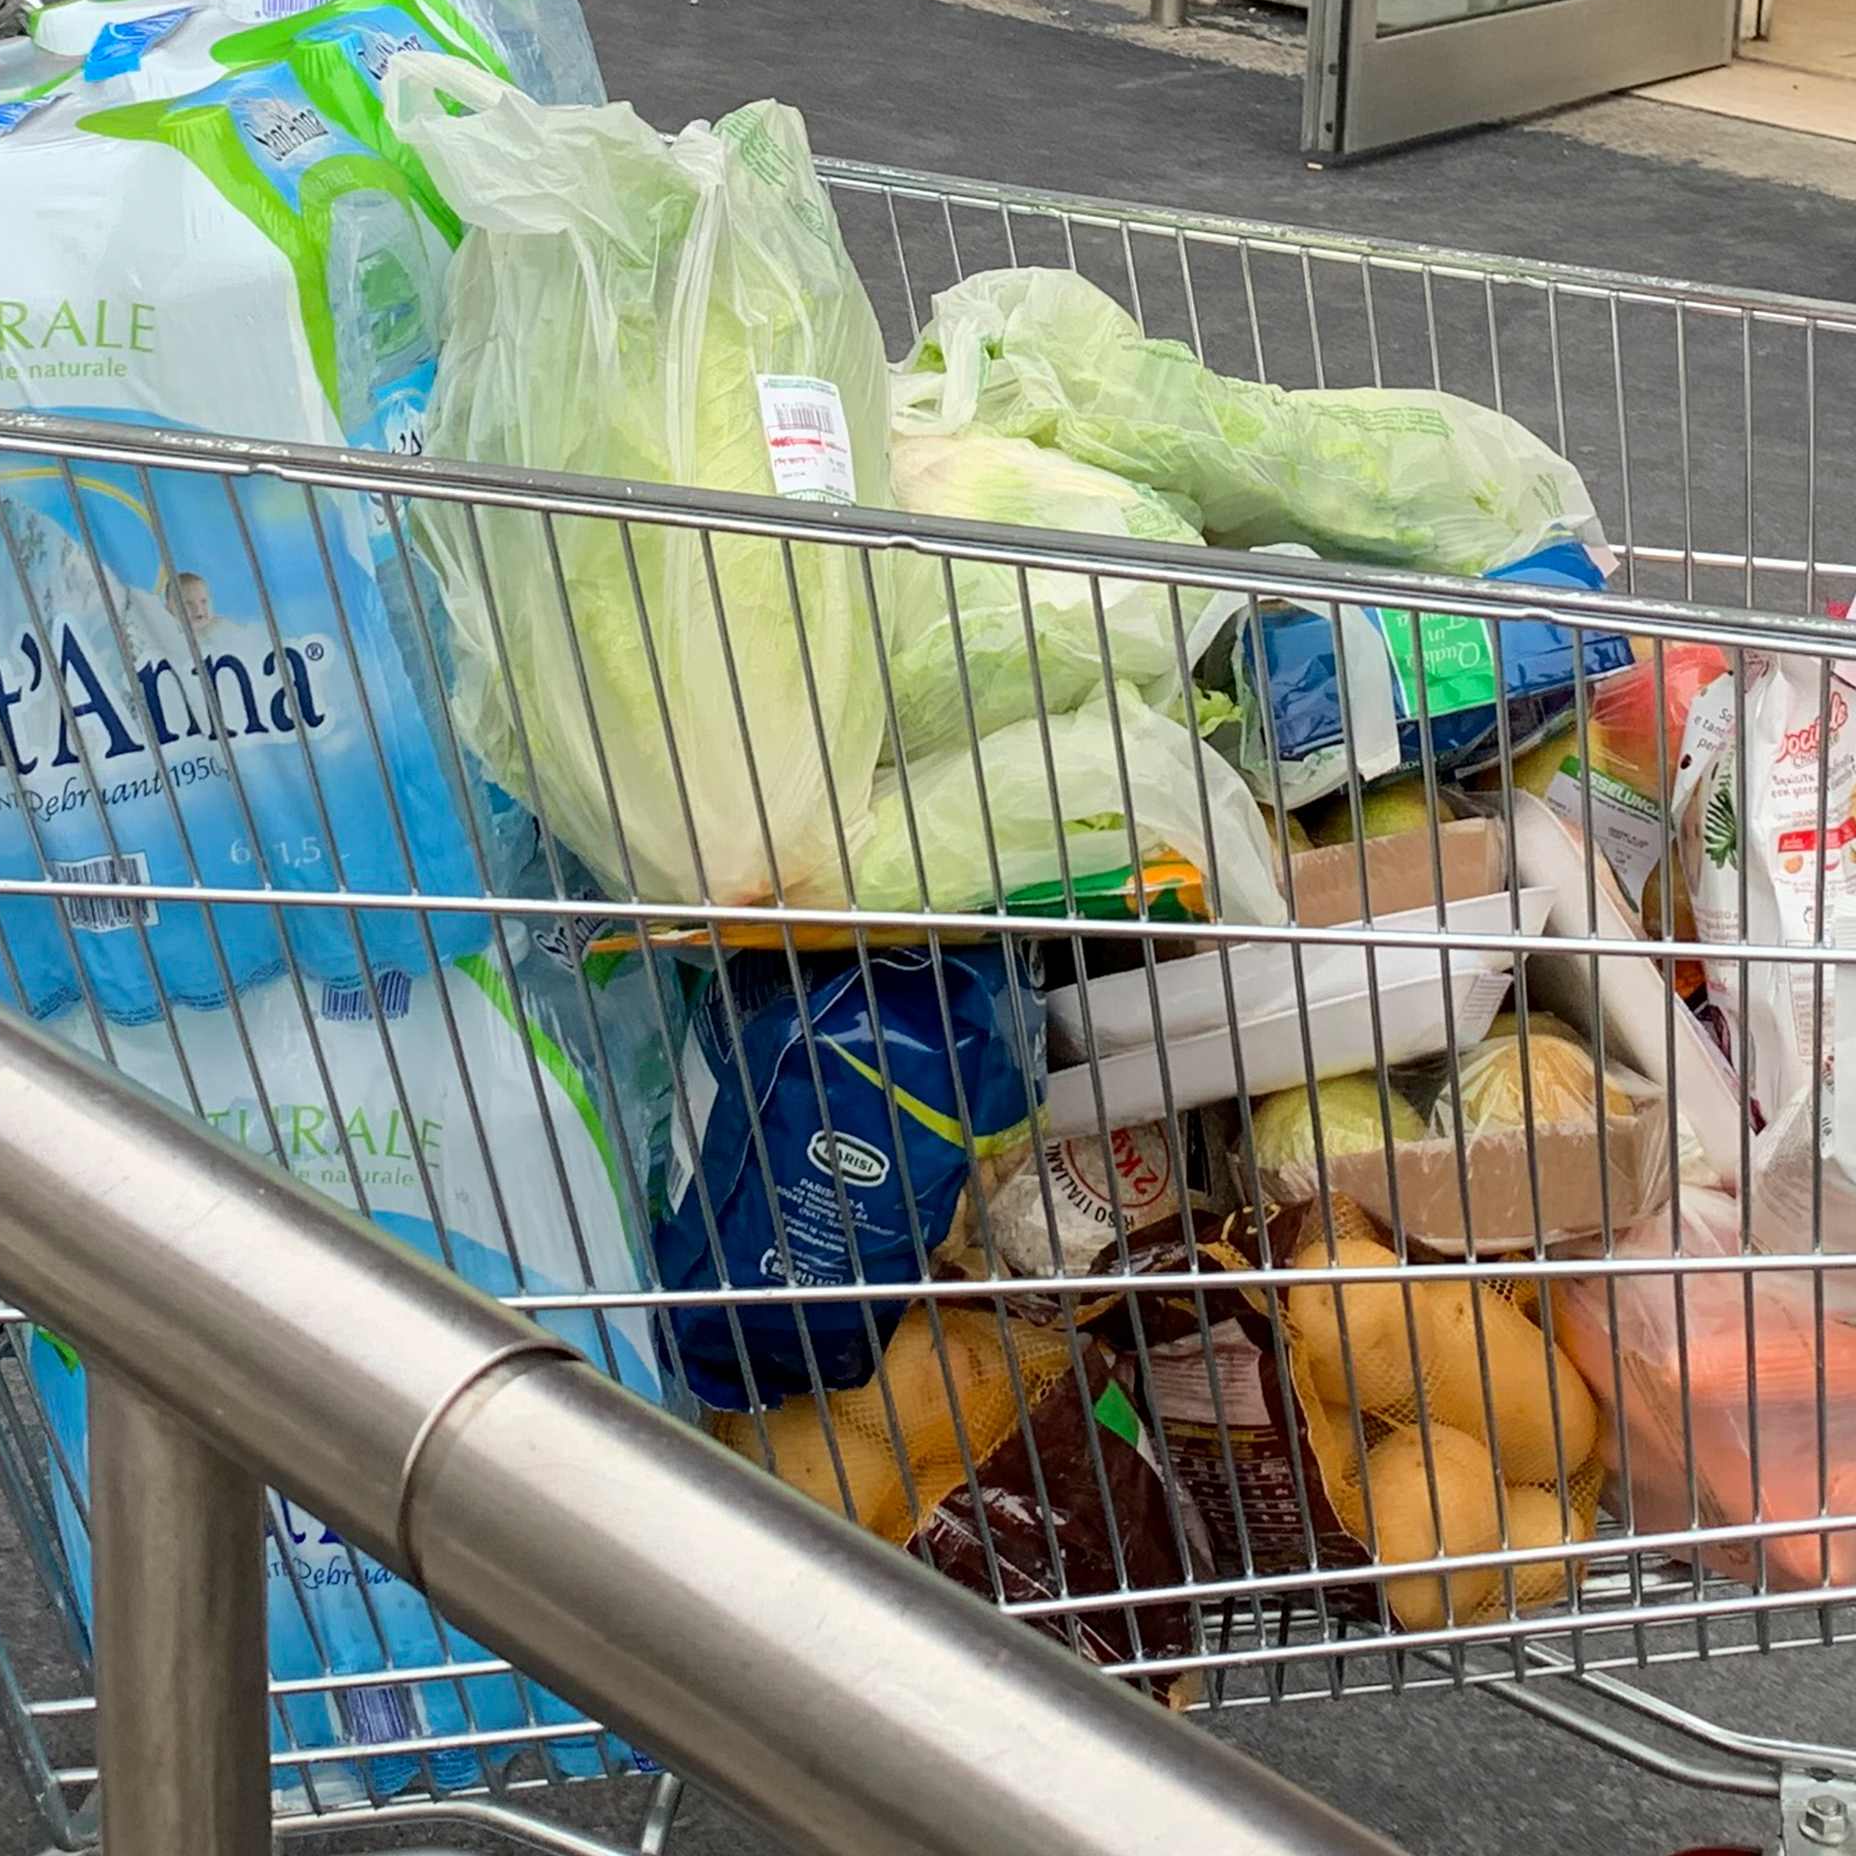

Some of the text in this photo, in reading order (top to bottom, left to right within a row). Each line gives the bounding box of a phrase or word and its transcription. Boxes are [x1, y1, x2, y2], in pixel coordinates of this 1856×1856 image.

[28, 356, 129, 380] naturale
[1406, 641, 1481, 676] Quali
[230, 839, 251, 865] 6
[320, 1167, 418, 1187] naurale
[1095, 1207, 1135, 1232] RSO
[294, 1554, 400, 1590] Rebra
